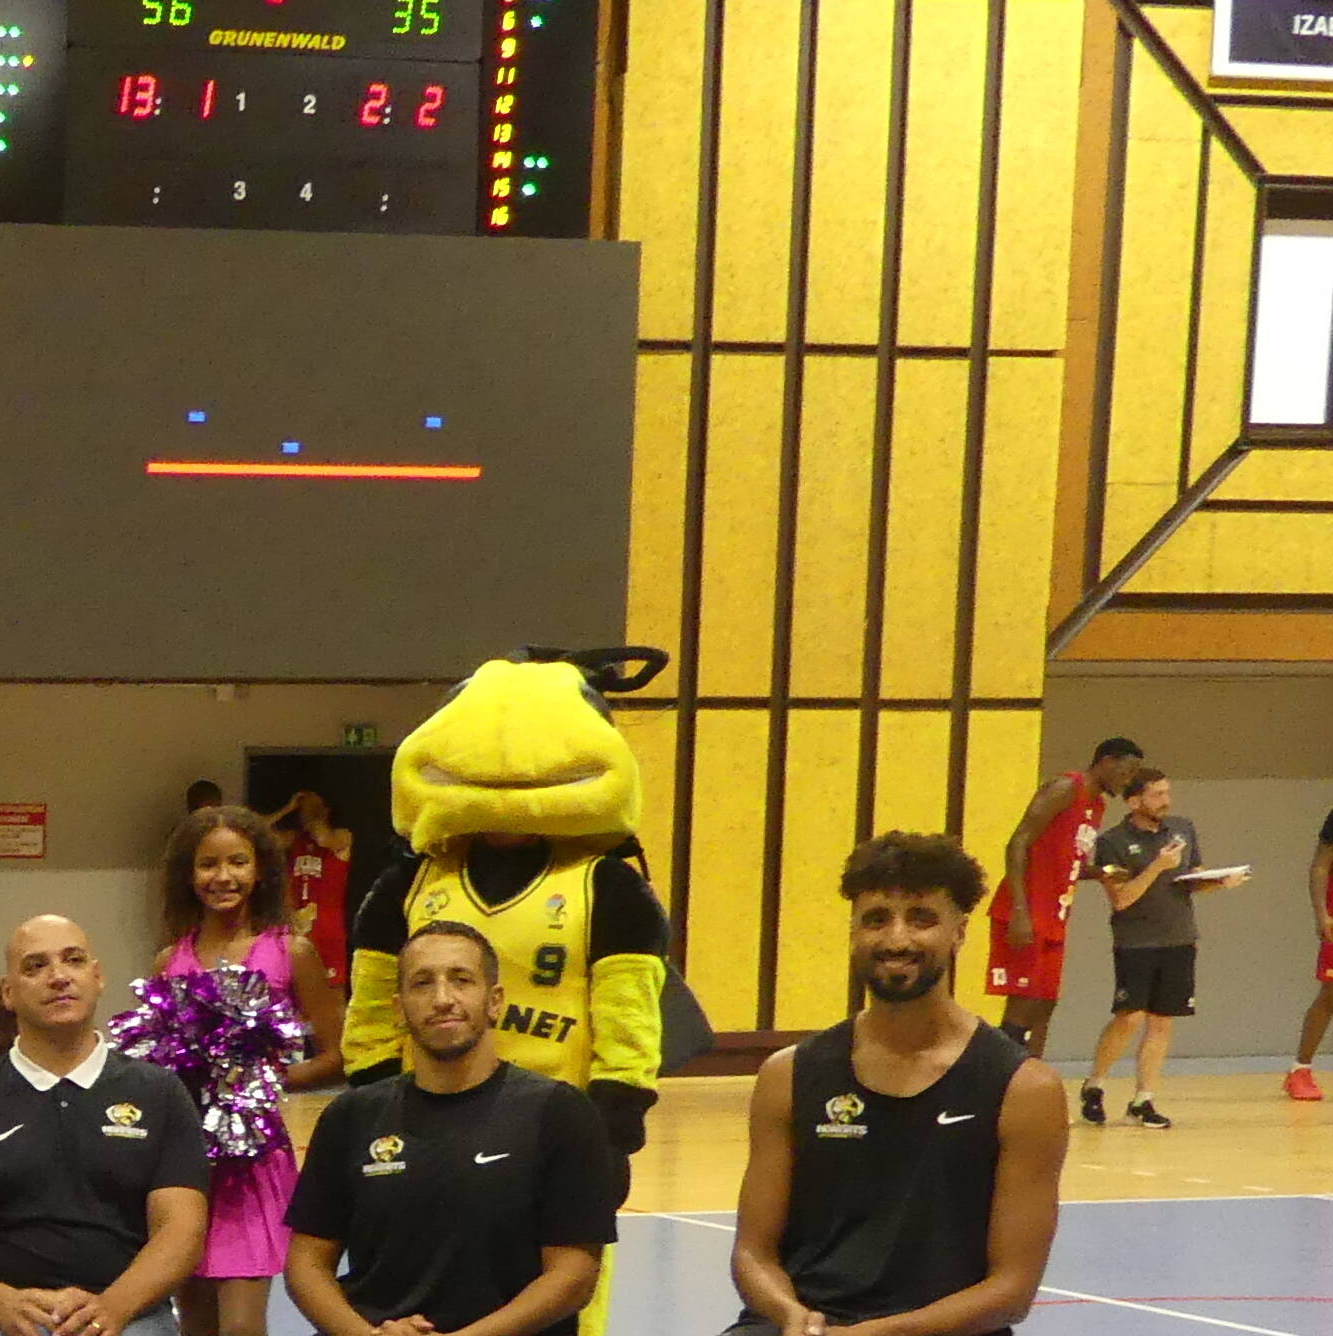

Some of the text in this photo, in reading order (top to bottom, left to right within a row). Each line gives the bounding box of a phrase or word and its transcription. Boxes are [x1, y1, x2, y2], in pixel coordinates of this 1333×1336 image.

[143, 0, 192, 26] 56
[393, 0, 440, 35] 35
[208, 29, 346, 51] GRUNENWALD
[496, 66, 516, 85] 11
[235, 91, 246, 112] 1
[302, 93, 317, 114] 2
[417, 85, 445, 127] 2
[495, 94, 514, 115] 12
[493, 123, 513, 143] 13
[233, 180, 246, 200] 3
[299, 182, 313, 202] 4
[493, 177, 511, 197] 15
[529, 942, 568, 987] 9
[494, 1003, 578, 1044] NET
